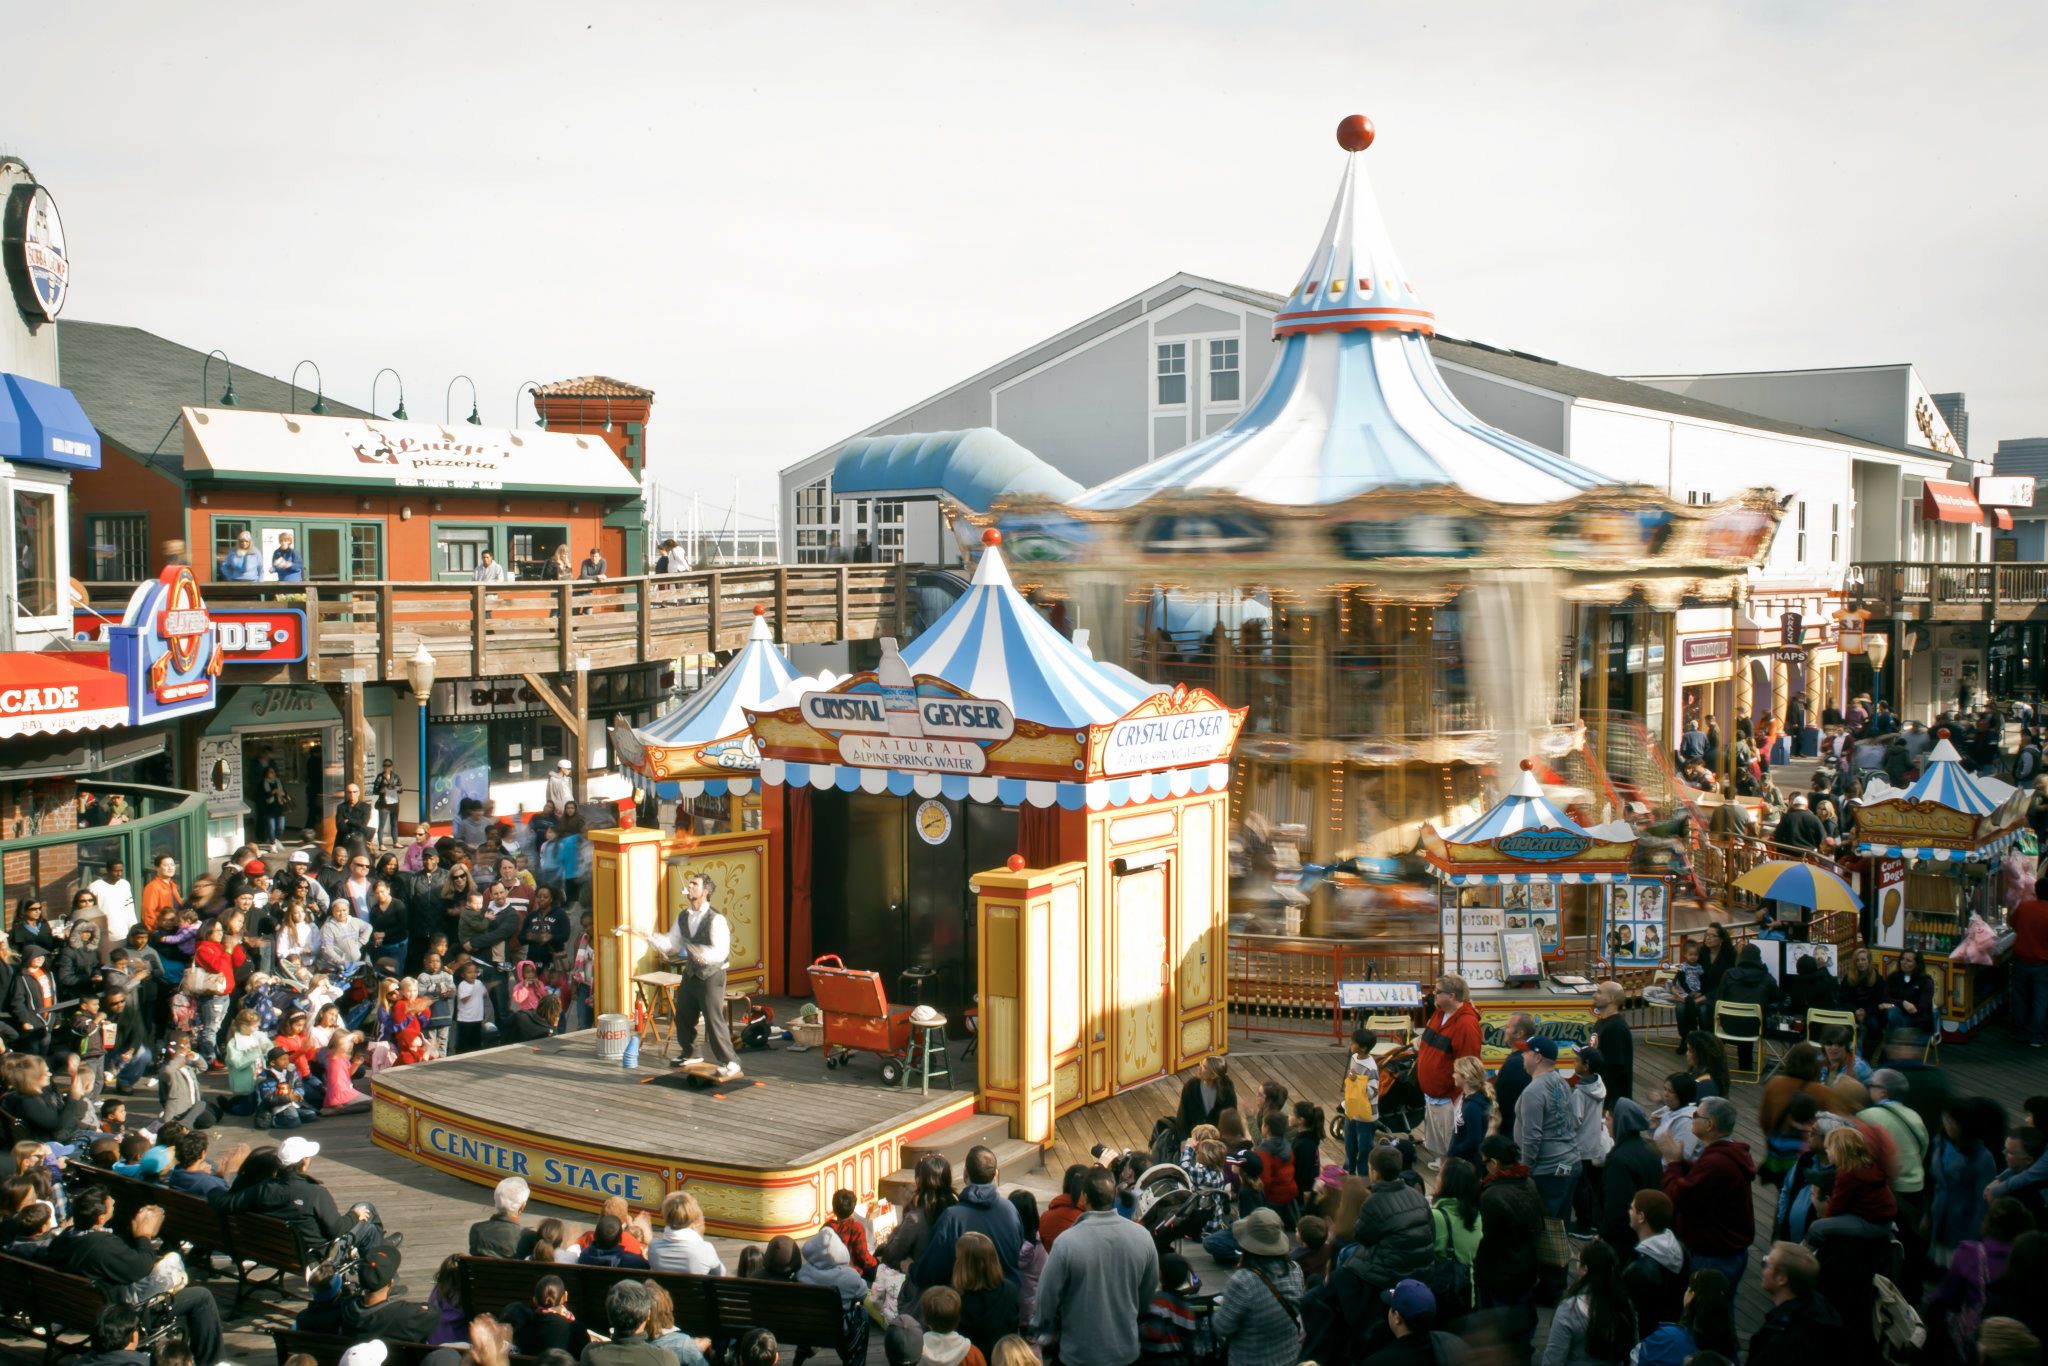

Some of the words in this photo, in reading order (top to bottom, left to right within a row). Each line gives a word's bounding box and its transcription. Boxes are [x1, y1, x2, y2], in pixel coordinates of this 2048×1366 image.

[411, 458, 497, 469] pizzeria
[1776, 652, 1805, 661] KAPS
[0, 686, 79, 713] CADE
[252, 686, 316, 717] Bliss
[810, 697, 885, 722] CRYSTAL
[923, 703, 1004, 729] GEYSER
[22, 720, 44, 730] BAY
[51, 718, 76, 728] VIEW
[1116, 721, 1170, 747] CRYSTAL
[1173, 716, 1222, 740] GEYSER
[861, 738, 965, 755] NATURAL
[853, 749, 891, 764] ALPINE
[892, 753, 933, 767] SPRING
[935, 757, 972, 770] WATER
[1861, 811, 1972, 834] CHURROS
[1499, 836, 1586, 851] CARICATURES
[1868, 836, 1901, 846] CORN
[1934, 841, 1967, 849] DOGS
[1881, 859, 1902, 873] Corn
[1883, 869, 1904, 884] Dogs
[1445, 914, 1500, 926] MDISON
[430, 1127, 530, 1176] CENTER
[543, 1158, 642, 1201] STAGE
